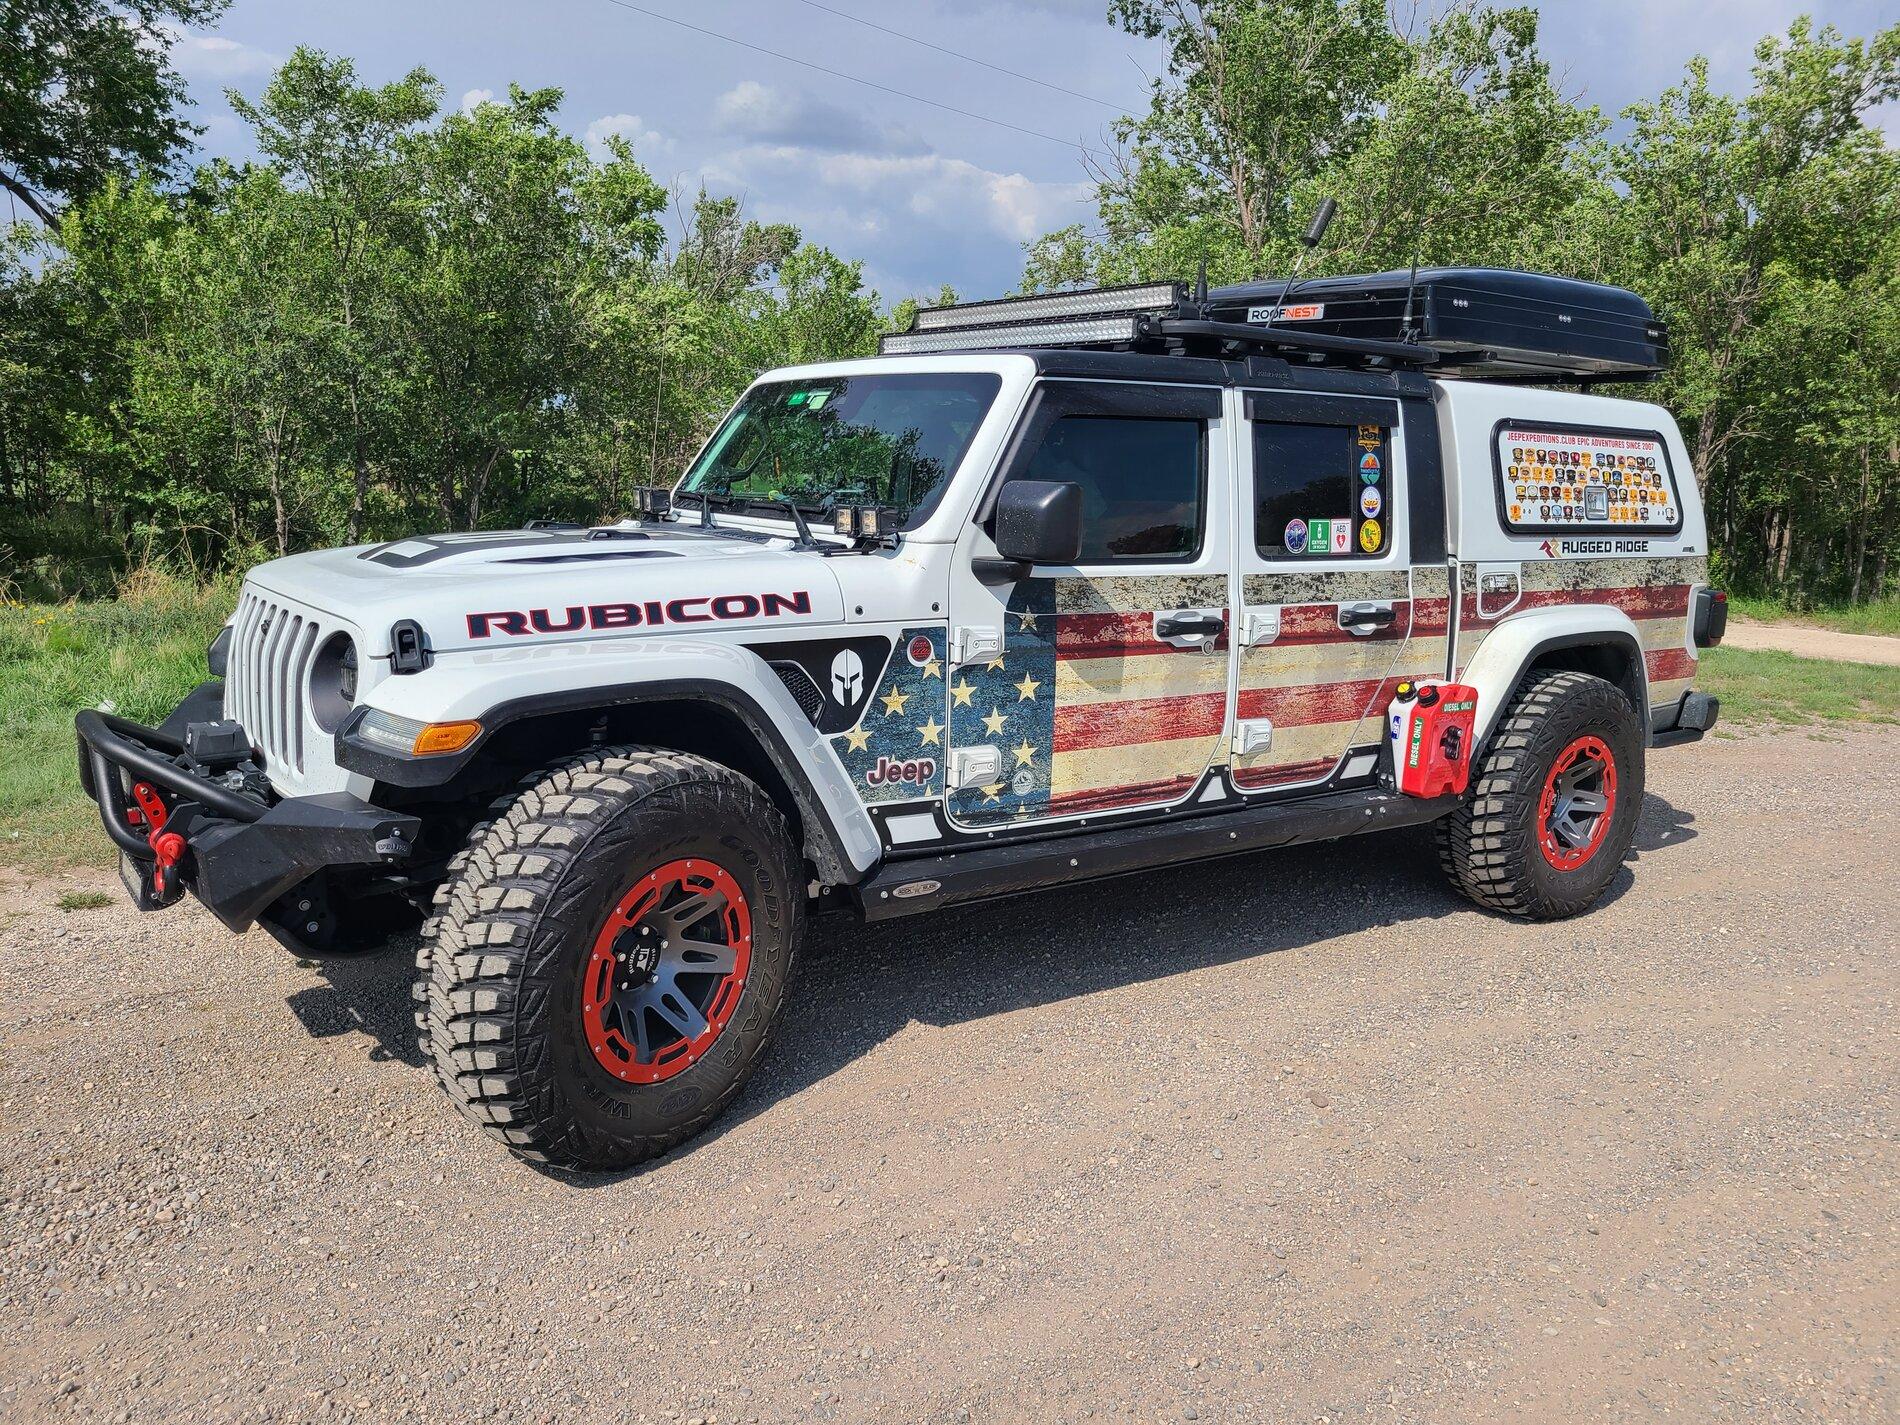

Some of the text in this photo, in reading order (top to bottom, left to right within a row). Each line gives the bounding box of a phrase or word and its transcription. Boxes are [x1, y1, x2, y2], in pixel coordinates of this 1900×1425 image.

[1251, 307, 1319, 320] ROOFNEST
[1507, 432, 1655, 451] JEEPEXPEDITIONS.CLUB EPIC ADVENTURES SINCE 2007
[1336, 525, 1346, 533] AED
[1561, 541, 1649, 554] RUGGED RIDGE
[466, 590, 812, 640] RUBICON
[1444, 701, 1473, 712] DIESEL ONLY
[1410, 720, 1422, 765] DIESEL ONLY
[867, 757, 936, 787] Jeep
